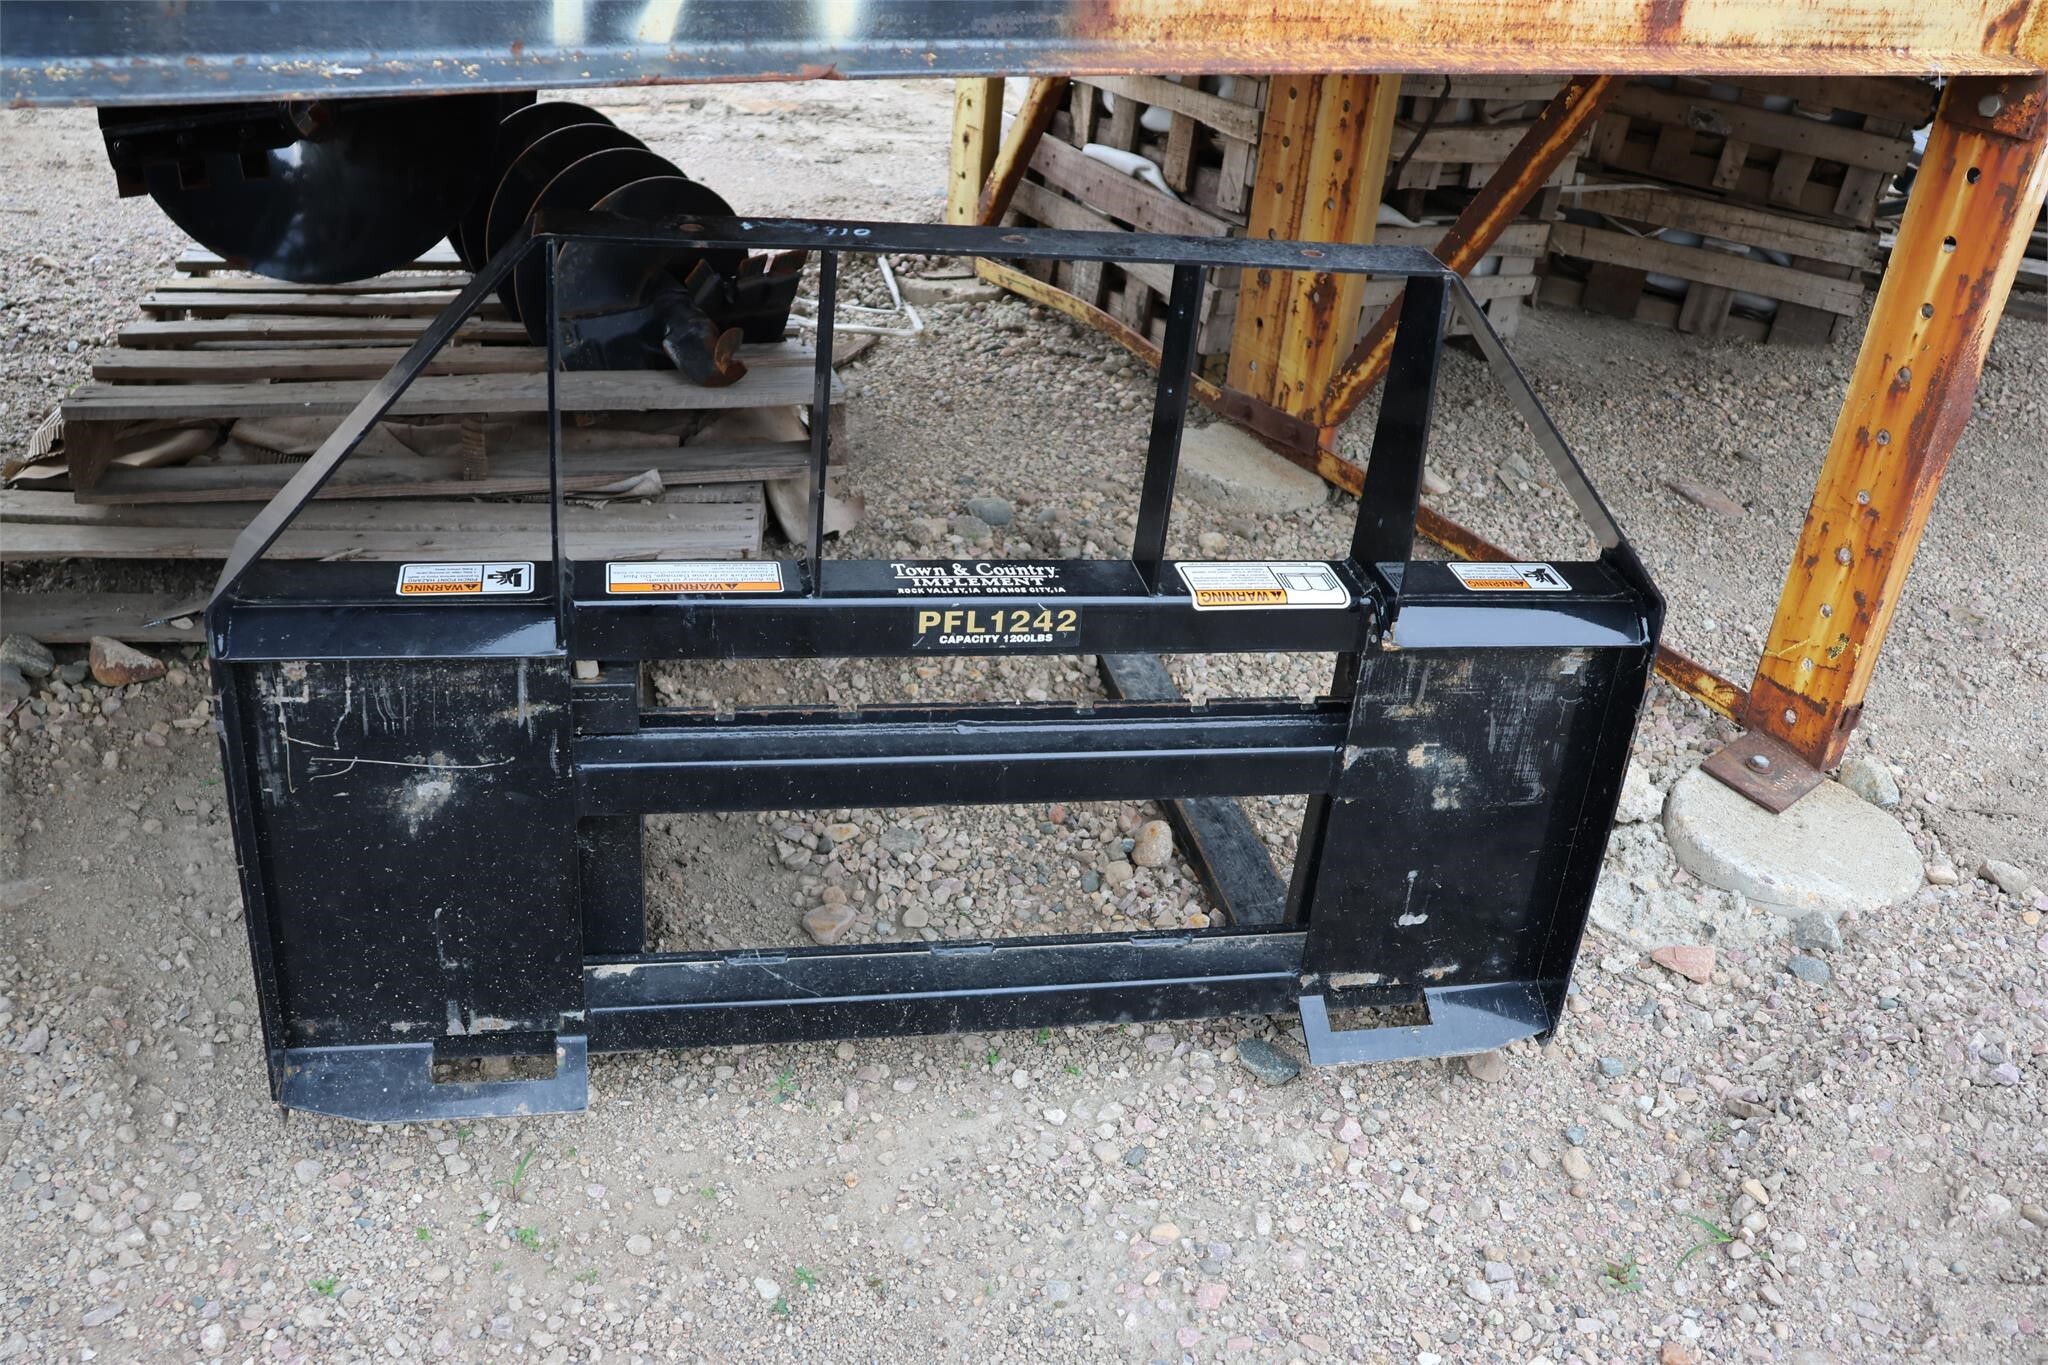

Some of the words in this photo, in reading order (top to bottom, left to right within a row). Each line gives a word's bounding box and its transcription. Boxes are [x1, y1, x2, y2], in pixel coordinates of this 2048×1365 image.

[890, 563, 947, 576] Town
[952, 562, 970, 576] &
[975, 562, 1056, 578] Country
[912, 578, 1045, 587] IMPLEMENT
[1200, 591, 1270, 604] WARNING
[918, 609, 1077, 634] PFL1242
[939, 634, 1000, 644] CAPACITY
[1003, 633, 1053, 643] 1200LBS
